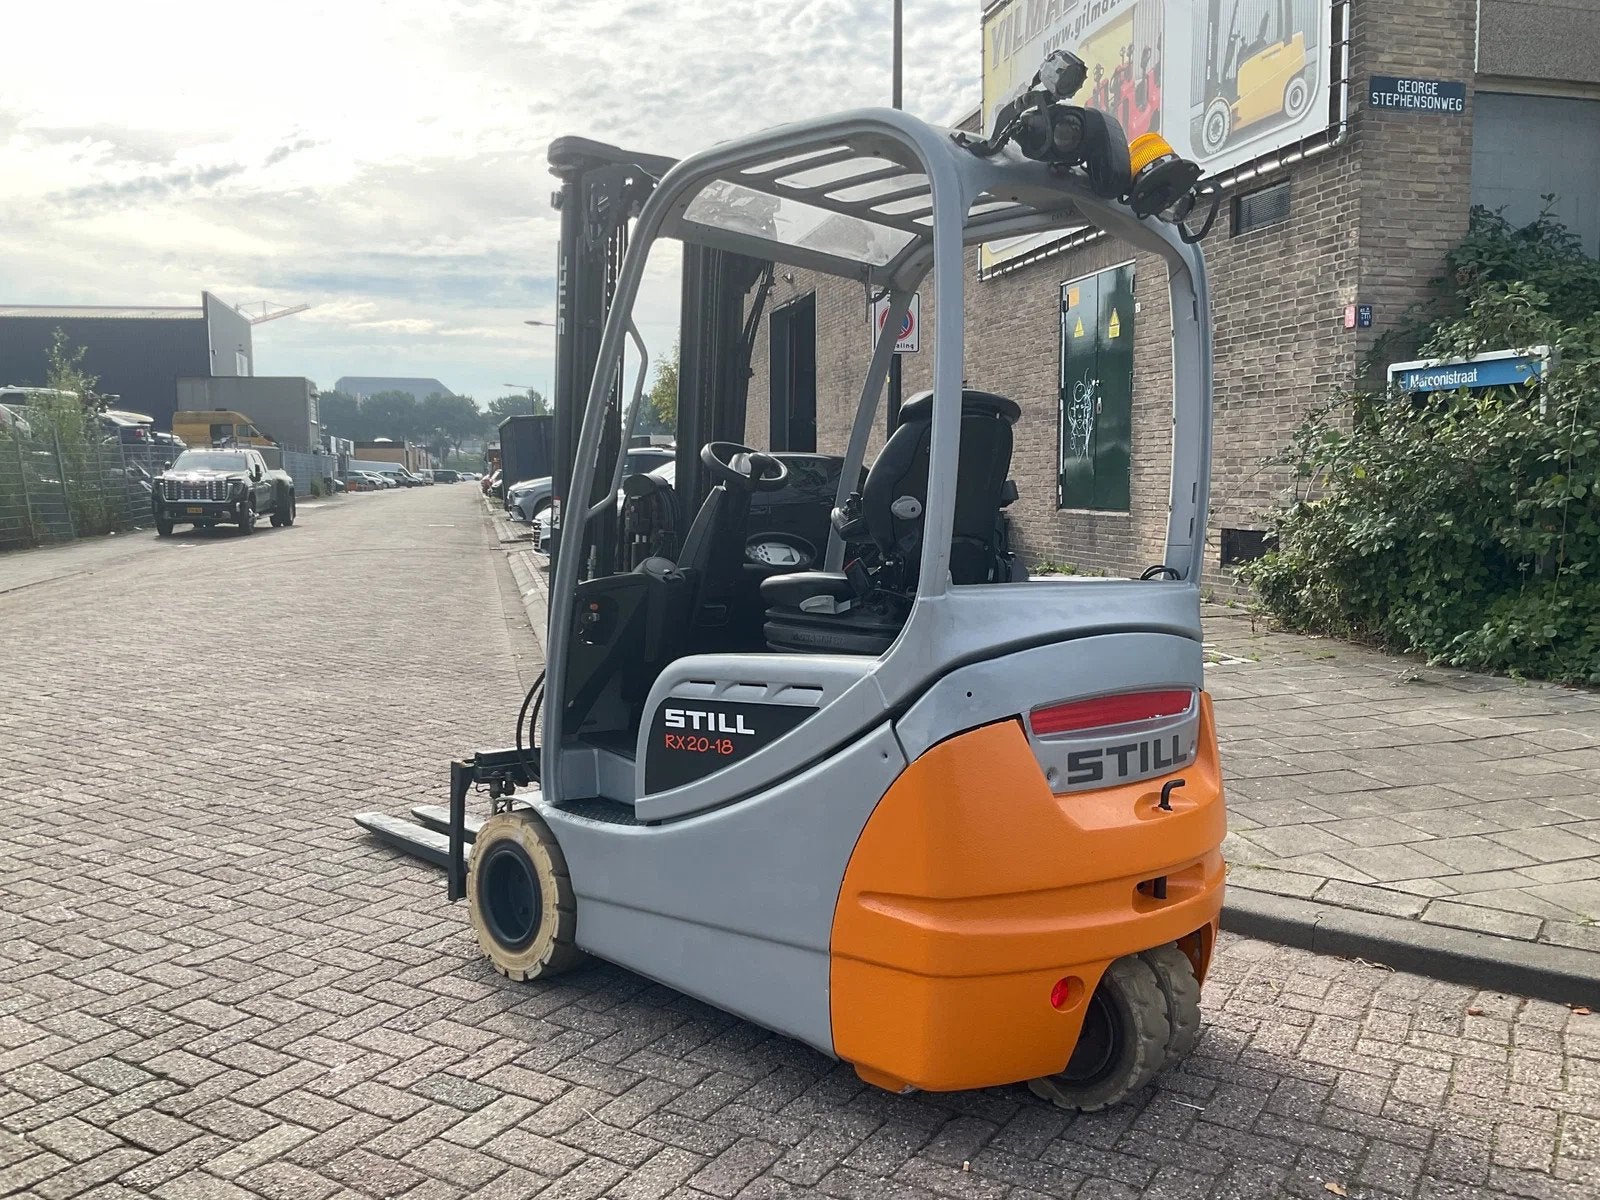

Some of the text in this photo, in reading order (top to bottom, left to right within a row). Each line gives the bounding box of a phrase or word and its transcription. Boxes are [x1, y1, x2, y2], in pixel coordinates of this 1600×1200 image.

[1397, 80, 1439, 95] GEORGE
[1372, 92, 1463, 111] STEPHENSONWEG
[559, 256, 567, 335] STILL
[1410, 368, 1478, 388] Marconistraat
[665, 708, 755, 735] STILL
[665, 734, 734, 755] RX20-18
[1067, 734, 1188, 785] STILL
